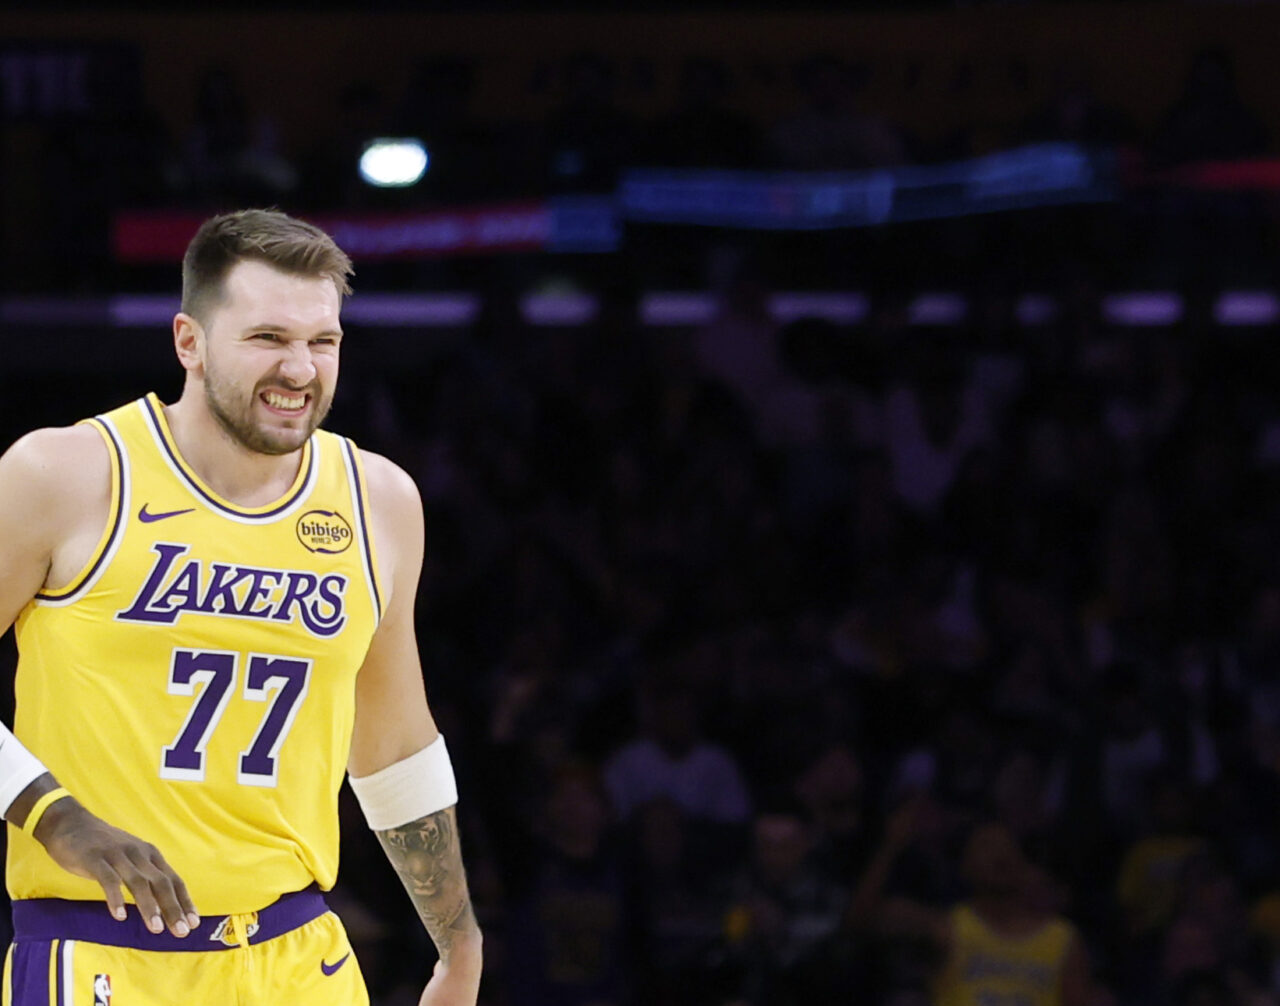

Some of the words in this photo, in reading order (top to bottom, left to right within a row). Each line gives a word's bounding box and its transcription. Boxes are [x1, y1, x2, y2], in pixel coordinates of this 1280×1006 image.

[301, 521, 349, 541] bibigo
[113, 541, 350, 639] LAKERS
[159, 646, 314, 788] 77
